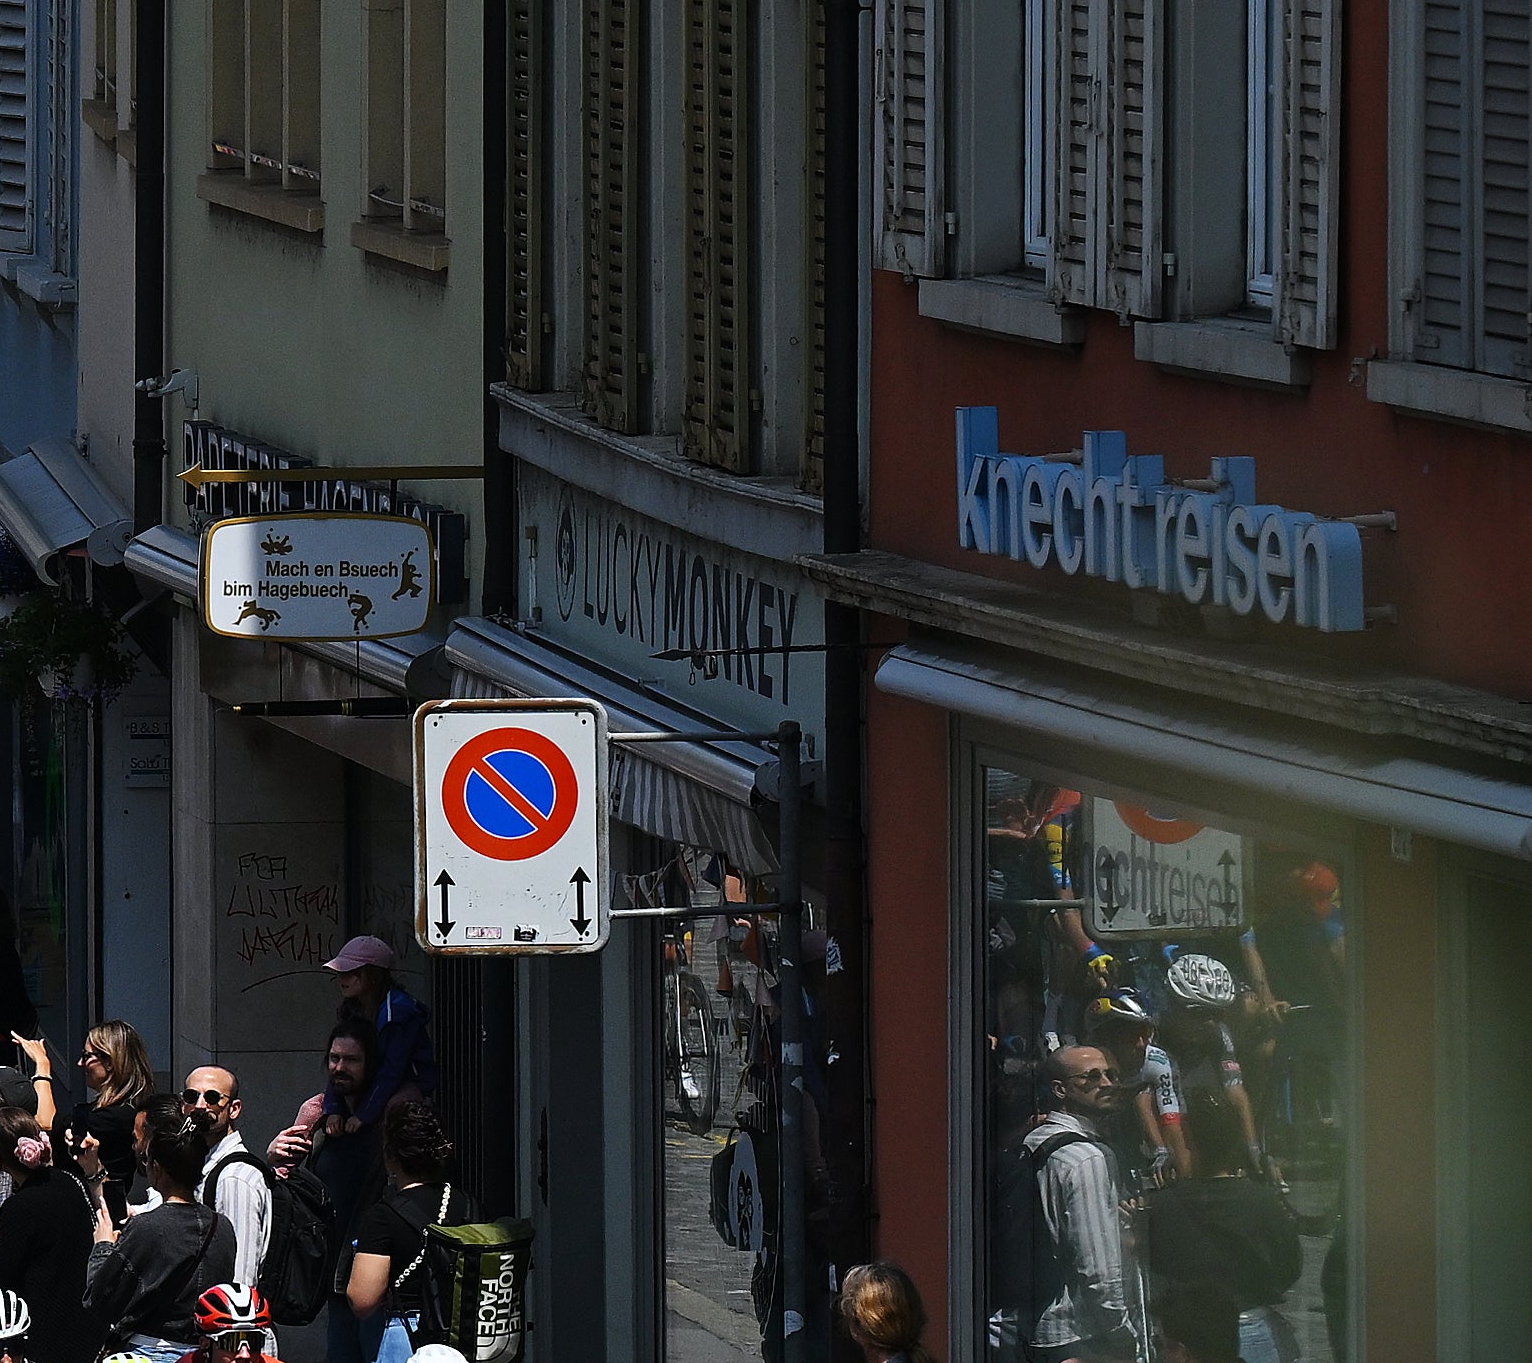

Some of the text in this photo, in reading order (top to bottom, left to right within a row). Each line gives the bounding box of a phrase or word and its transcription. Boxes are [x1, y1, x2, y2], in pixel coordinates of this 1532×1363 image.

[954, 406, 1348, 632] knecht reisen
[223, 581, 348, 600] bim Hagebuech
[266, 561, 398, 578] Mach en Bsuech
[478, 1277, 497, 1356] FACE
[498, 1253, 514, 1339] NORTH
